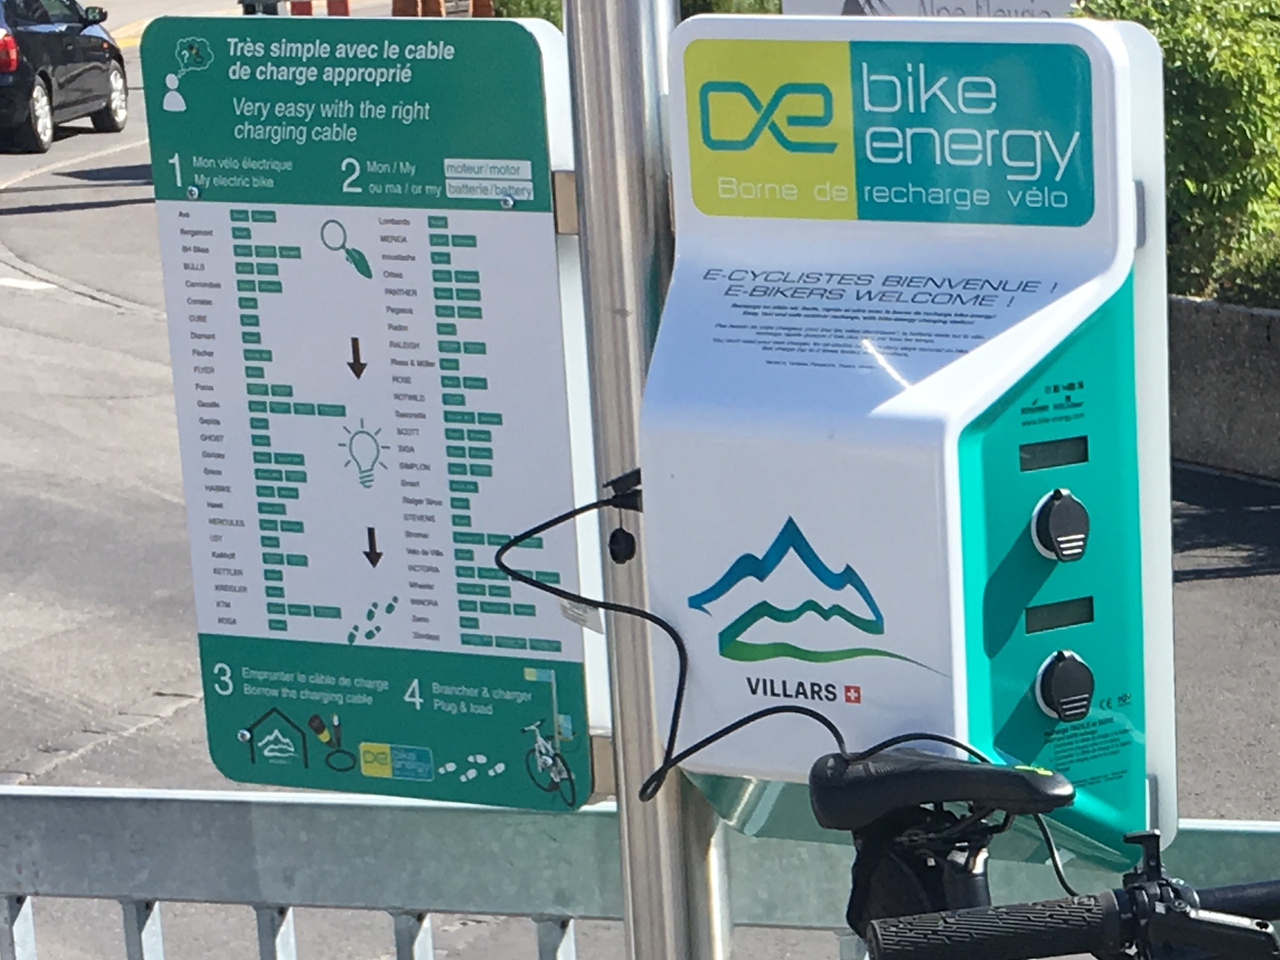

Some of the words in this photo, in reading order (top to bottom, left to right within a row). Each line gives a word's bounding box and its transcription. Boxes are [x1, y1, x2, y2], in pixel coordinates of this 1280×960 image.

[227, 38, 265, 58] Très
[270, 38, 330, 63] simple
[335, 43, 379, 61] avec
[382, 42, 400, 60] le
[404, 43, 455, 61] cable
[228, 62, 250, 80] de
[256, 64, 318, 84] charge
[322, 65, 413, 85] approprié
[862, 62, 998, 115] bike
[233, 97, 271, 119] Very
[276, 101, 316, 121] easy
[320, 99, 357, 118] with
[360, 100, 386, 119] the
[390, 101, 430, 124] right
[234, 123, 306, 144] charging
[311, 123, 358, 142] cable
[192, 156, 216, 168] Mon
[241, 156, 293, 172] électrique
[865, 125, 1081, 183] energy
[168, 152, 183, 187] 1
[194, 174, 211, 188] My
[213, 175, 251, 187] electric
[252, 176, 275, 188] bike
[340, 156, 363, 194] 2
[367, 160, 391, 174] Mon
[399, 161, 416, 177] My
[369, 183, 382, 194] ou
[385, 184, 402, 194] ma
[411, 185, 422, 194] or
[425, 186, 442, 198] my
[718, 177, 798, 201] Borne
[814, 180, 849, 202] de
[864, 185, 990, 212] recharge
[1006, 185, 1069, 209] vélo
[703, 268, 875, 286] E-CYCLISTES
[882, 275, 1041, 293] BIENVENUE
[724, 284, 847, 301] E-BIKERS
[855, 290, 998, 307] WELCOME
[213, 662, 234, 696] 3
[242, 667, 295, 683] Emprunter
[297, 672, 306, 683] le
[338, 676, 351, 687] de
[353, 677, 389, 692] charge
[746, 677, 837, 702] VILLARS
[243, 684, 279, 697] Borrow
[281, 686, 298, 699] the
[299, 688, 344, 705] charging
[345, 693, 374, 705] cable
[403, 678, 424, 711] 4
[431, 682, 479, 697] Brancher
[481, 688, 490, 698] &
[492, 689, 532, 703] charger
[433, 699, 458, 715] Plug
[459, 701, 467, 712] &
[469, 703, 494, 715] load
